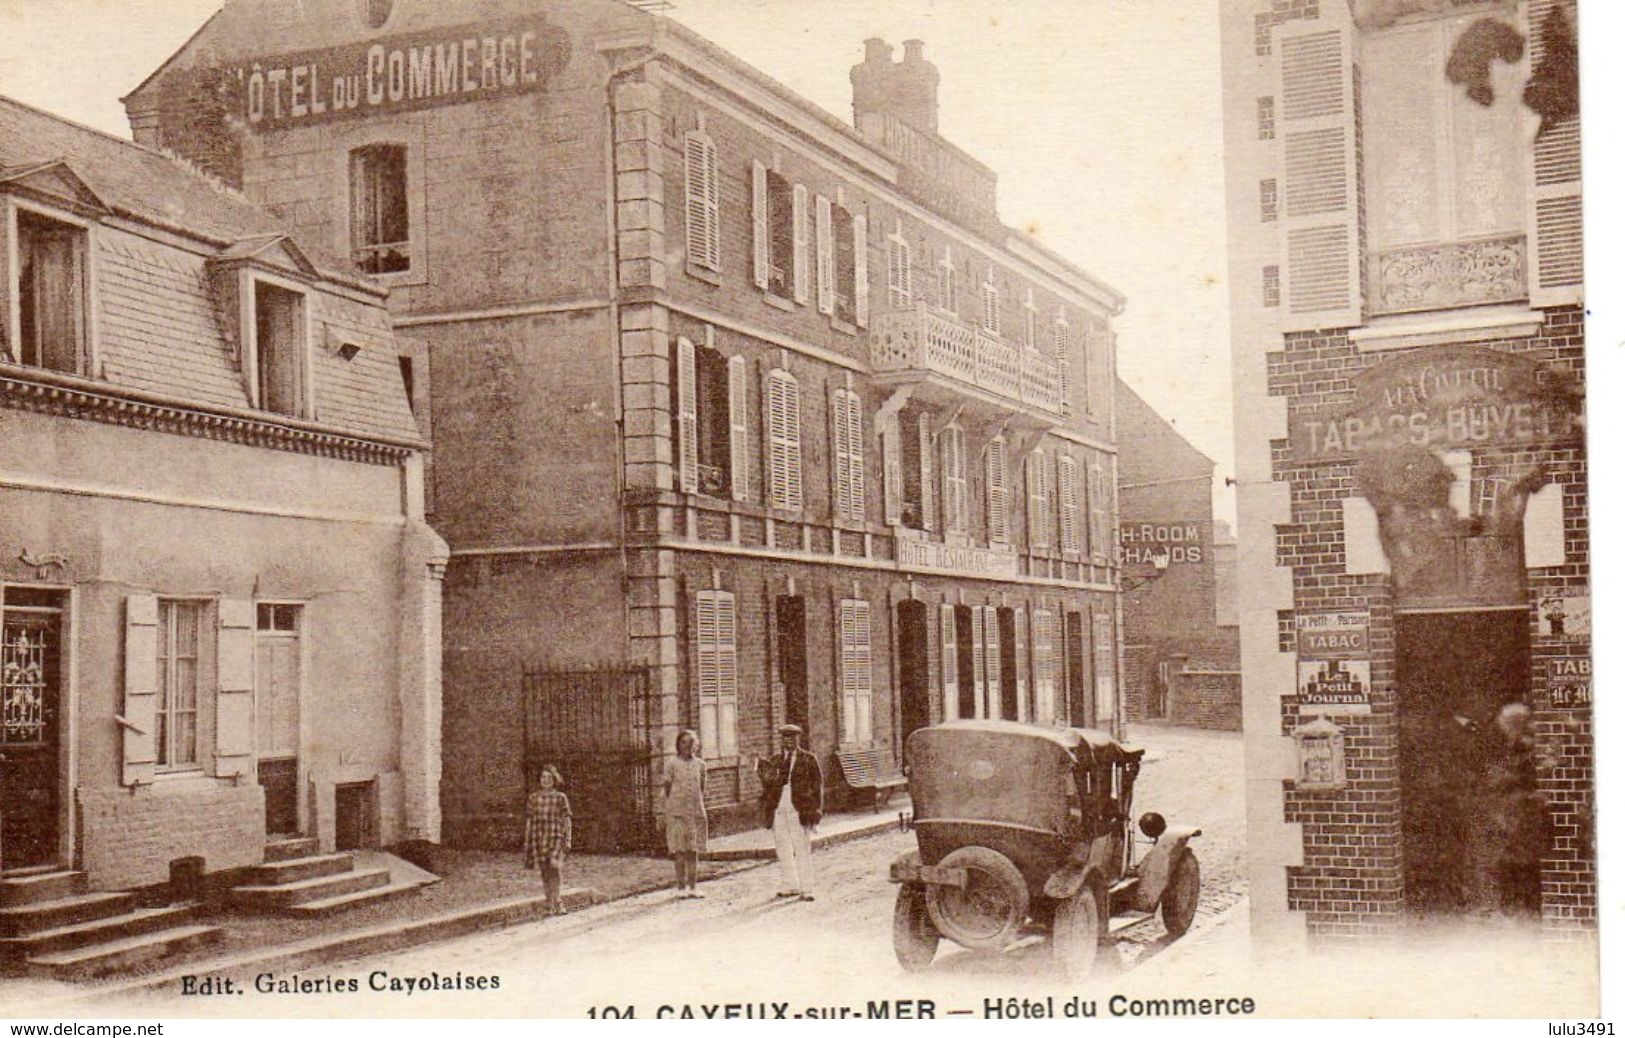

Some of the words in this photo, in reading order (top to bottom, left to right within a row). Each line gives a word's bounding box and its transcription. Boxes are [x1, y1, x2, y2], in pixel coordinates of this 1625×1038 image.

[228, 62, 328, 123] ÔTEL
[332, 75, 360, 110] DU
[367, 32, 538, 105] COMMERCE
[1310, 634, 1361, 649] TABAC
[1325, 672, 1343, 681] Le
[1317, 682, 1353, 692] Petit
[1302, 694, 1368, 704] Journal
